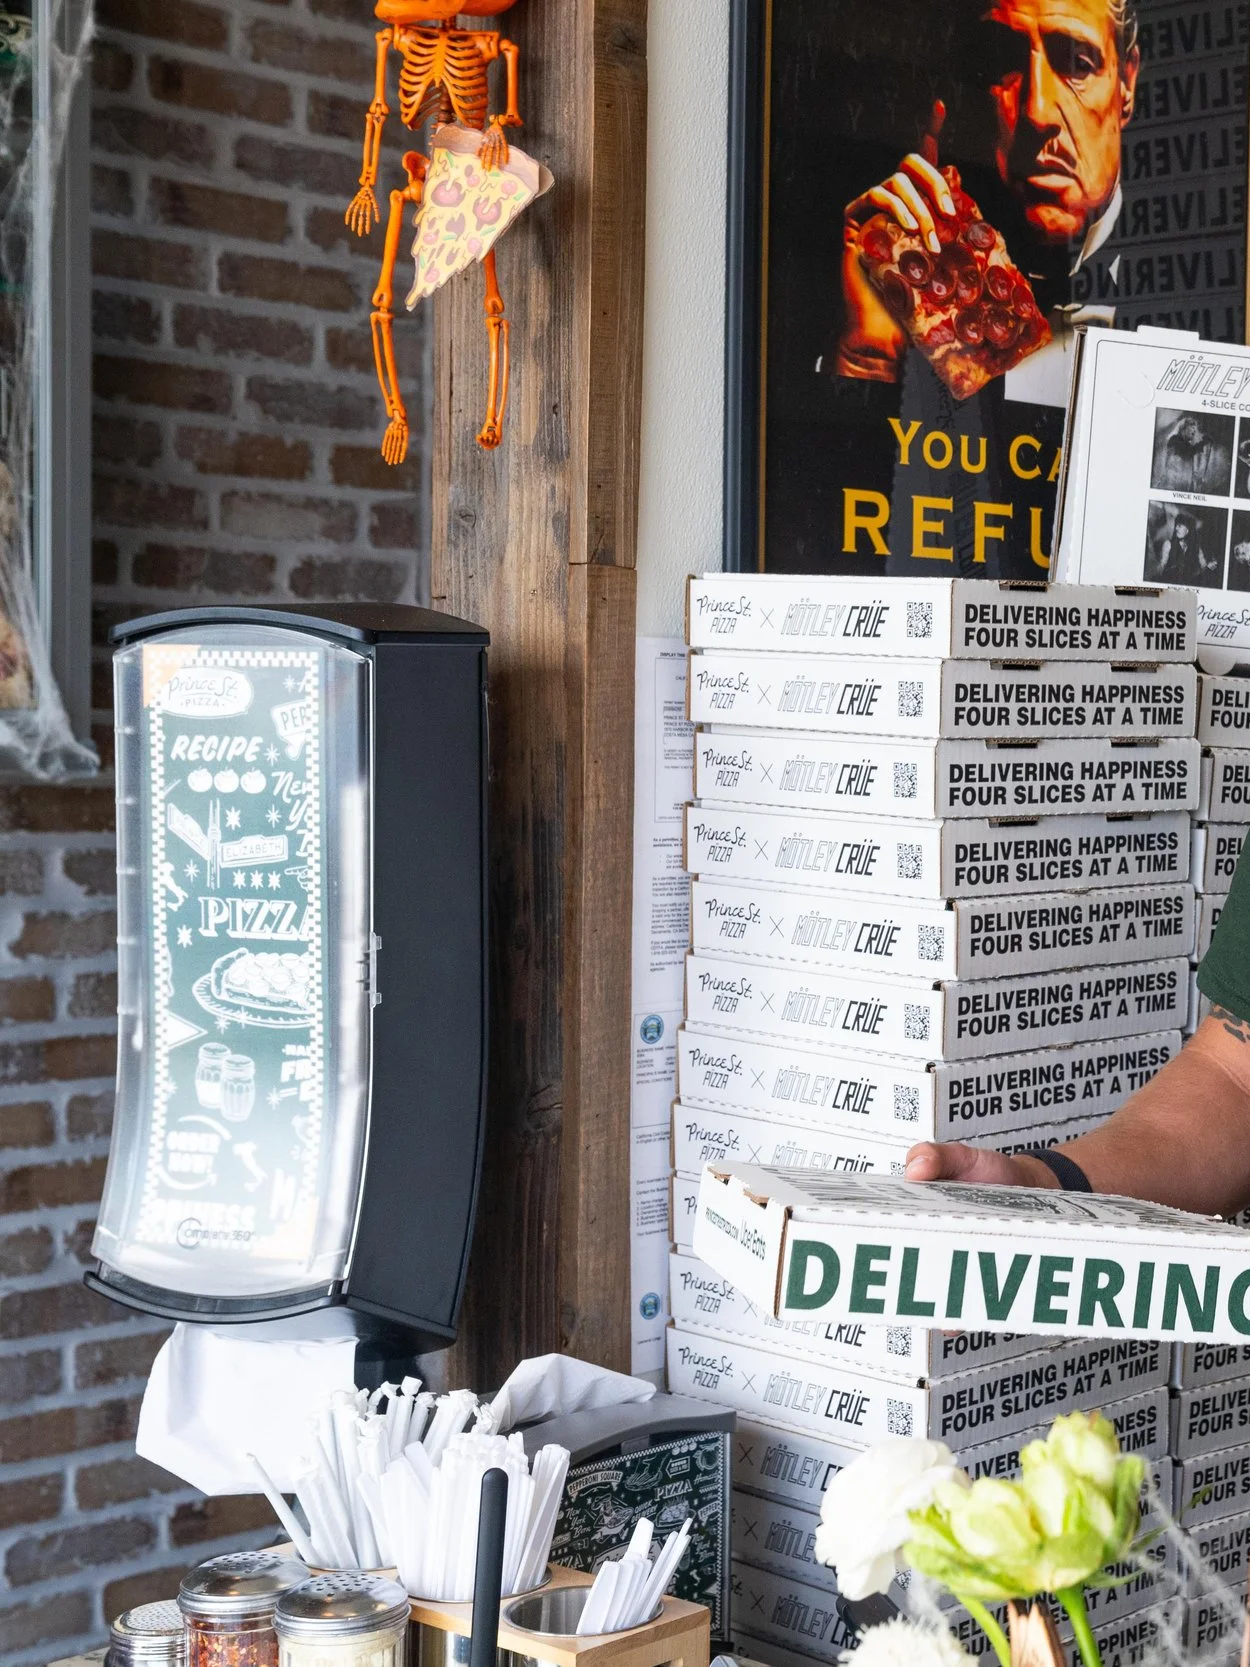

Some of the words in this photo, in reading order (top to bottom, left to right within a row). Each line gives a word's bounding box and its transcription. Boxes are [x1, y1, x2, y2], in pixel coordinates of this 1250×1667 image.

[1201, 399, 1237, 411] 4-SLICE
[887, 417, 989, 475] YOU
[841, 488, 1051, 570] REFU
[697, 595, 737, 617] Prince
[780, 597, 847, 637] MÖTLEY
[843, 599, 890, 638] CRÜE
[964, 603, 1081, 627] DELIVERING
[1087, 608, 1187, 630] HAPPINESS
[964, 627, 1019, 648] FOUR
[1025, 628, 1092, 650] SLICES
[1097, 630, 1121, 650] AT
[1125, 631, 1138, 650] A
[1143, 631, 1186, 651] TIME
[170, 734, 264, 762] RECIPE
[703, 749, 738, 769] Prince
[779, 754, 838, 794] MÖTLEY
[835, 759, 878, 797] CRÜE
[226, 842, 282, 858] ELIZABETH
[955, 837, 1072, 864] DELIVERING
[1078, 831, 1179, 856] HAPPINESS
[954, 864, 1009, 887] FOUR
[1015, 859, 1083, 882] SLICES
[1088, 857, 1112, 877] AT
[1116, 856, 1130, 875] A
[1135, 853, 1178, 874] TIME
[699, 973, 737, 992] Prince
[957, 983, 1073, 1016] DELIVERING
[1079, 970, 1177, 1001] HAPPINESS
[781, 986, 845, 1029] MÖTLEY
[842, 997, 888, 1035] CRÜE
[957, 1013, 1011, 1039] FOUR
[1016, 1003, 1084, 1031] SLICES
[1088, 1000, 1112, 1021] AT
[1116, 998, 1129, 1017] A
[1134, 991, 1177, 1015] TIME
[678, 1347, 717, 1370] Prince
[942, 1363, 1058, 1415] DELIVERING
[1062, 1339, 1160, 1379] HAPPINESS
[763, 1370, 828, 1415] MÖTLEY
[824, 1388, 871, 1427] CRÜE
[941, 1403, 995, 1437] FOUR
[1000, 1381, 1068, 1418] SLICES
[1072, 1372, 1096, 1397] AT
[1099, 1368, 1112, 1389] A
[1117, 1352, 1159, 1382] TIME
[1188, 1414, 1233, 1439] FOUR
[600, 1471, 622, 1483] SQUARE
[654, 1481, 694, 1501] PIZZA
